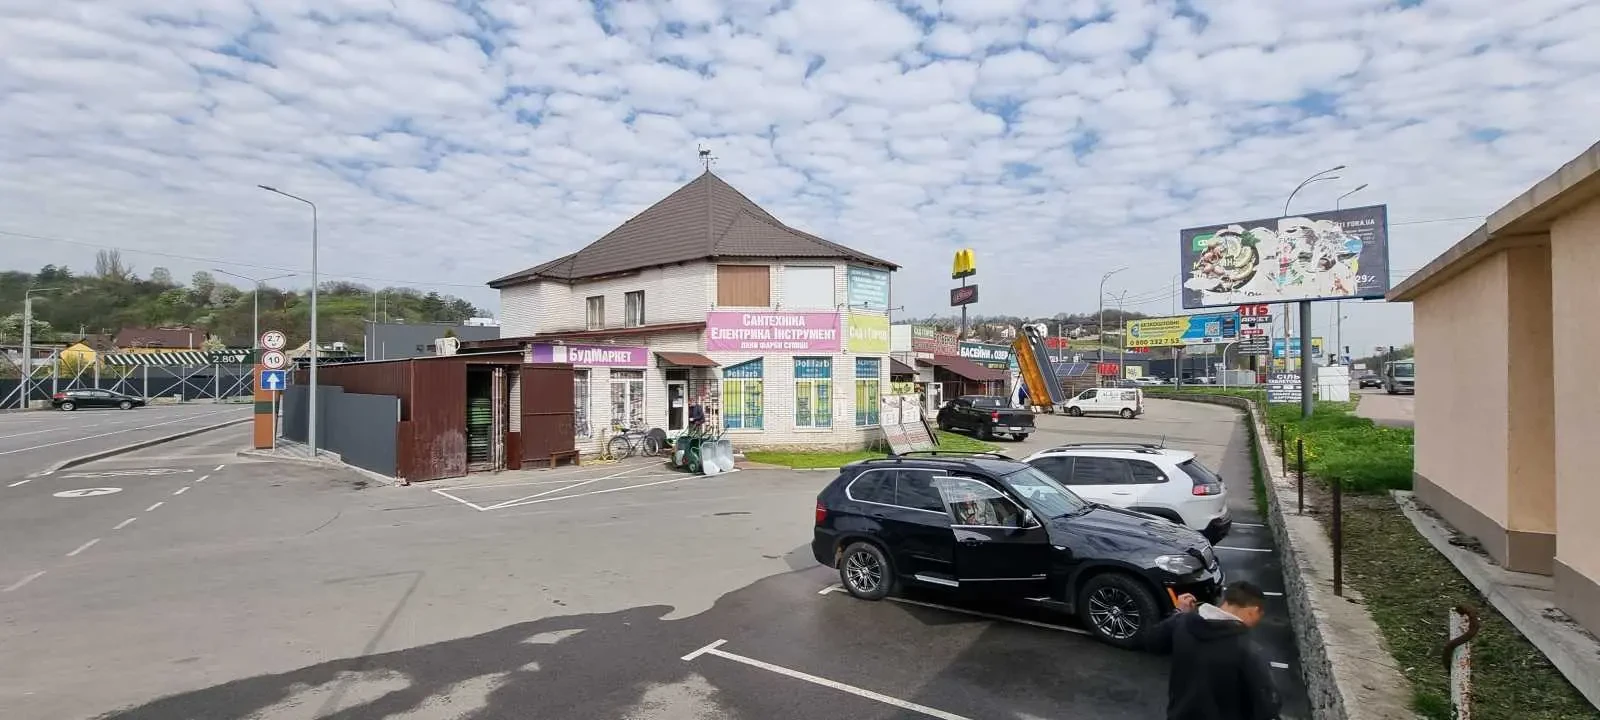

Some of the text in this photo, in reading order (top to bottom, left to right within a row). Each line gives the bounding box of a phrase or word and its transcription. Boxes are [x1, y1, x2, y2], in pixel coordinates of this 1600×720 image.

[743, 314, 805, 327] САНТЕХНІКА
[711, 327, 836, 340] ЕЛЕКТРИКА ІНСТРУМЕНТ
[212, 355, 235, 363] 2.80
[961, 346, 991, 359] БАСЕЙНИ
[268, 356, 280, 364] 10
